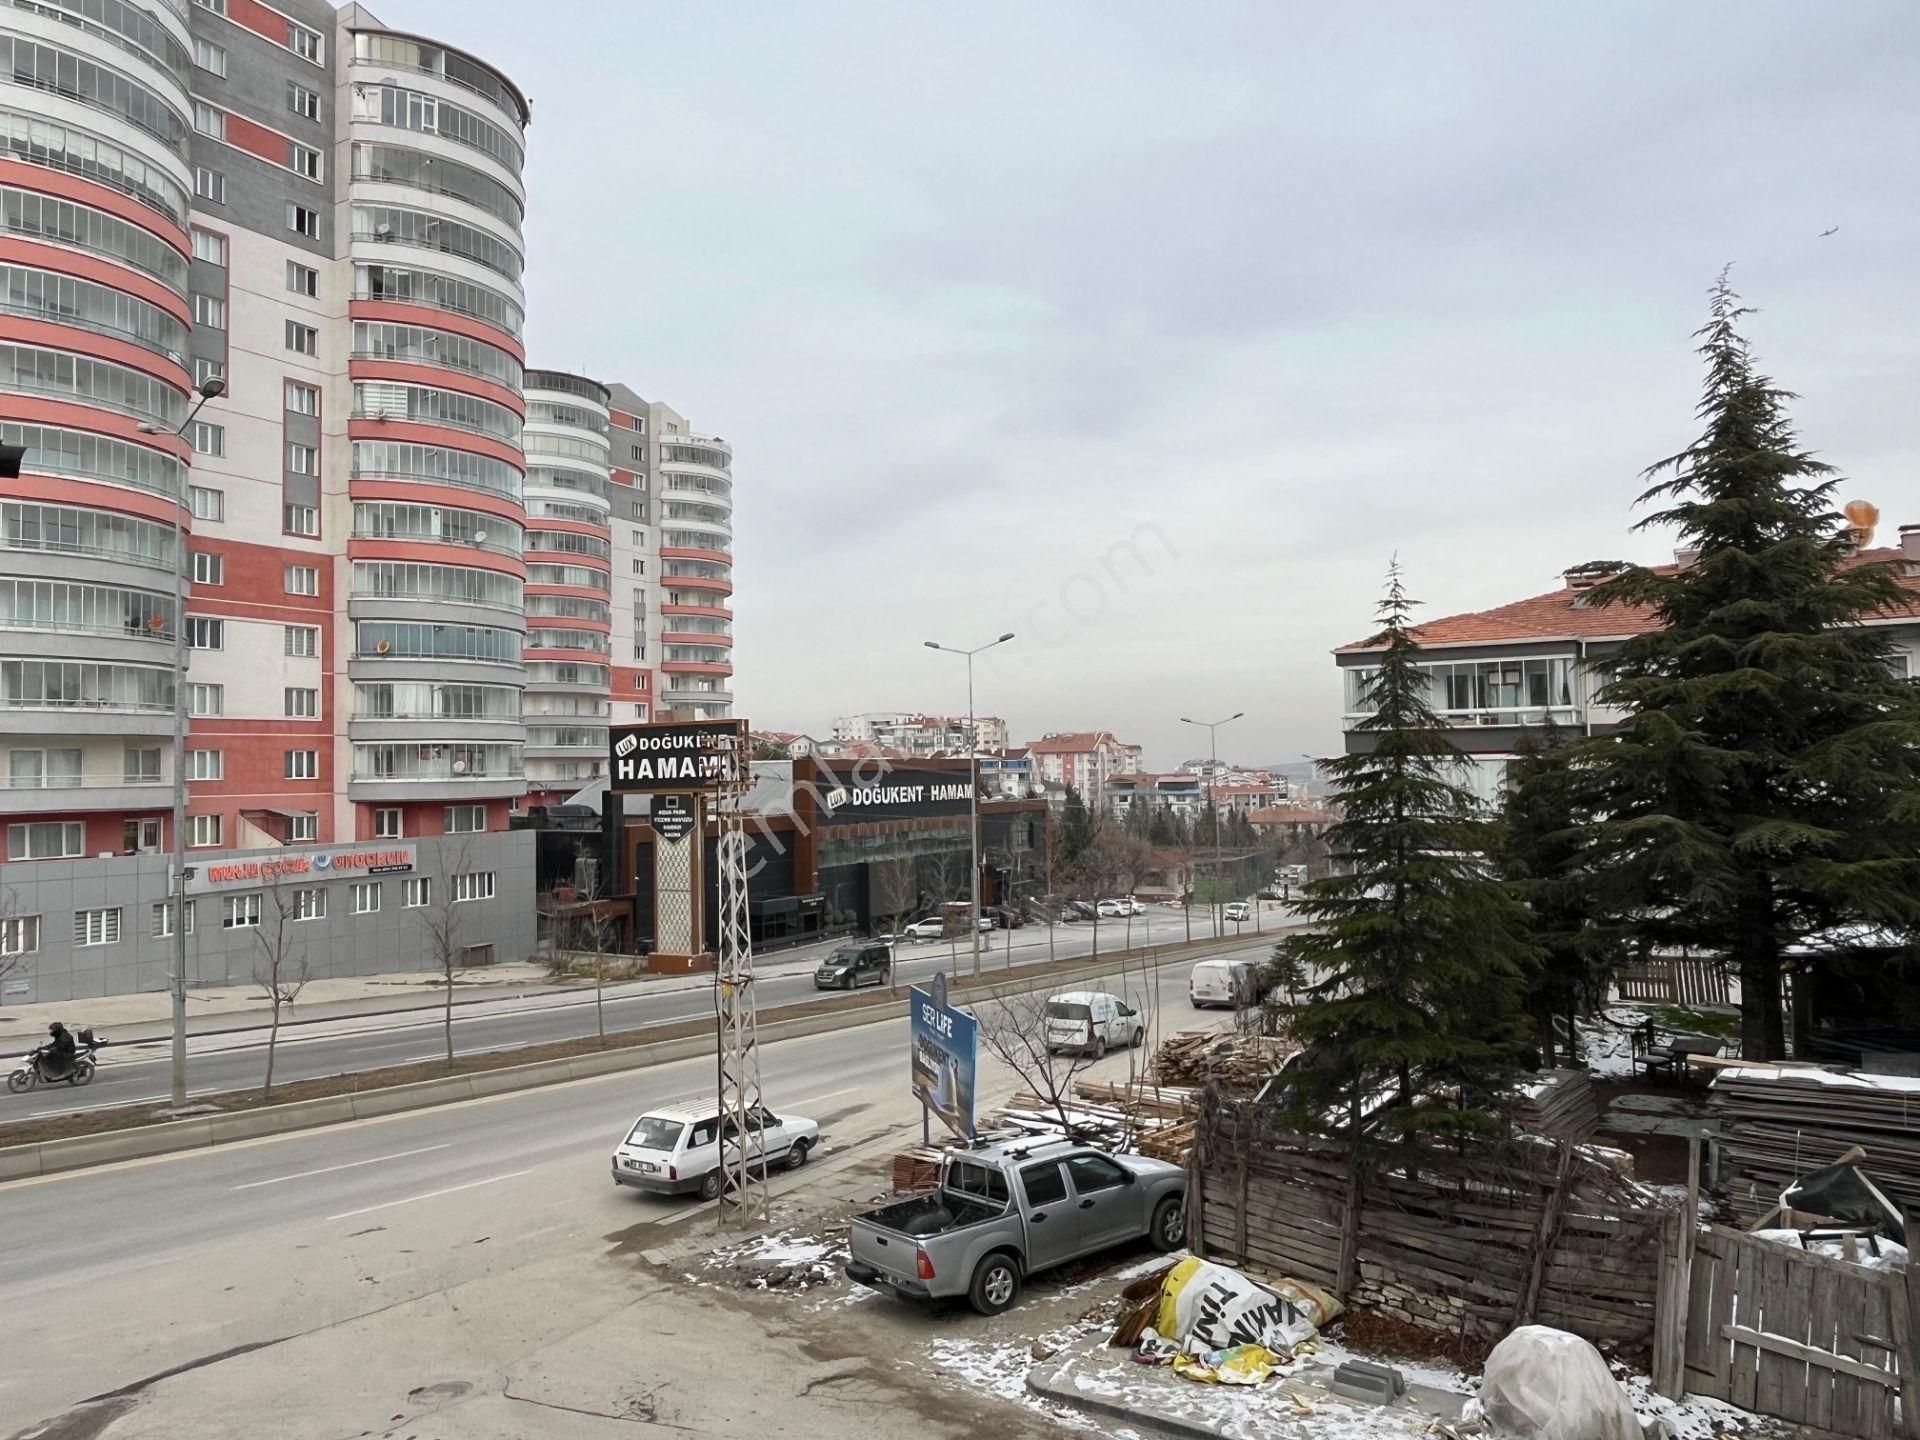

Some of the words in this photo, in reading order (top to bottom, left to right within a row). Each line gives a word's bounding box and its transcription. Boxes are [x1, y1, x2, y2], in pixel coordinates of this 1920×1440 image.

[617, 737, 636, 755] LUX
[829, 789, 845, 807] LUX
[853, 783, 924, 806] DOĞUKENT
